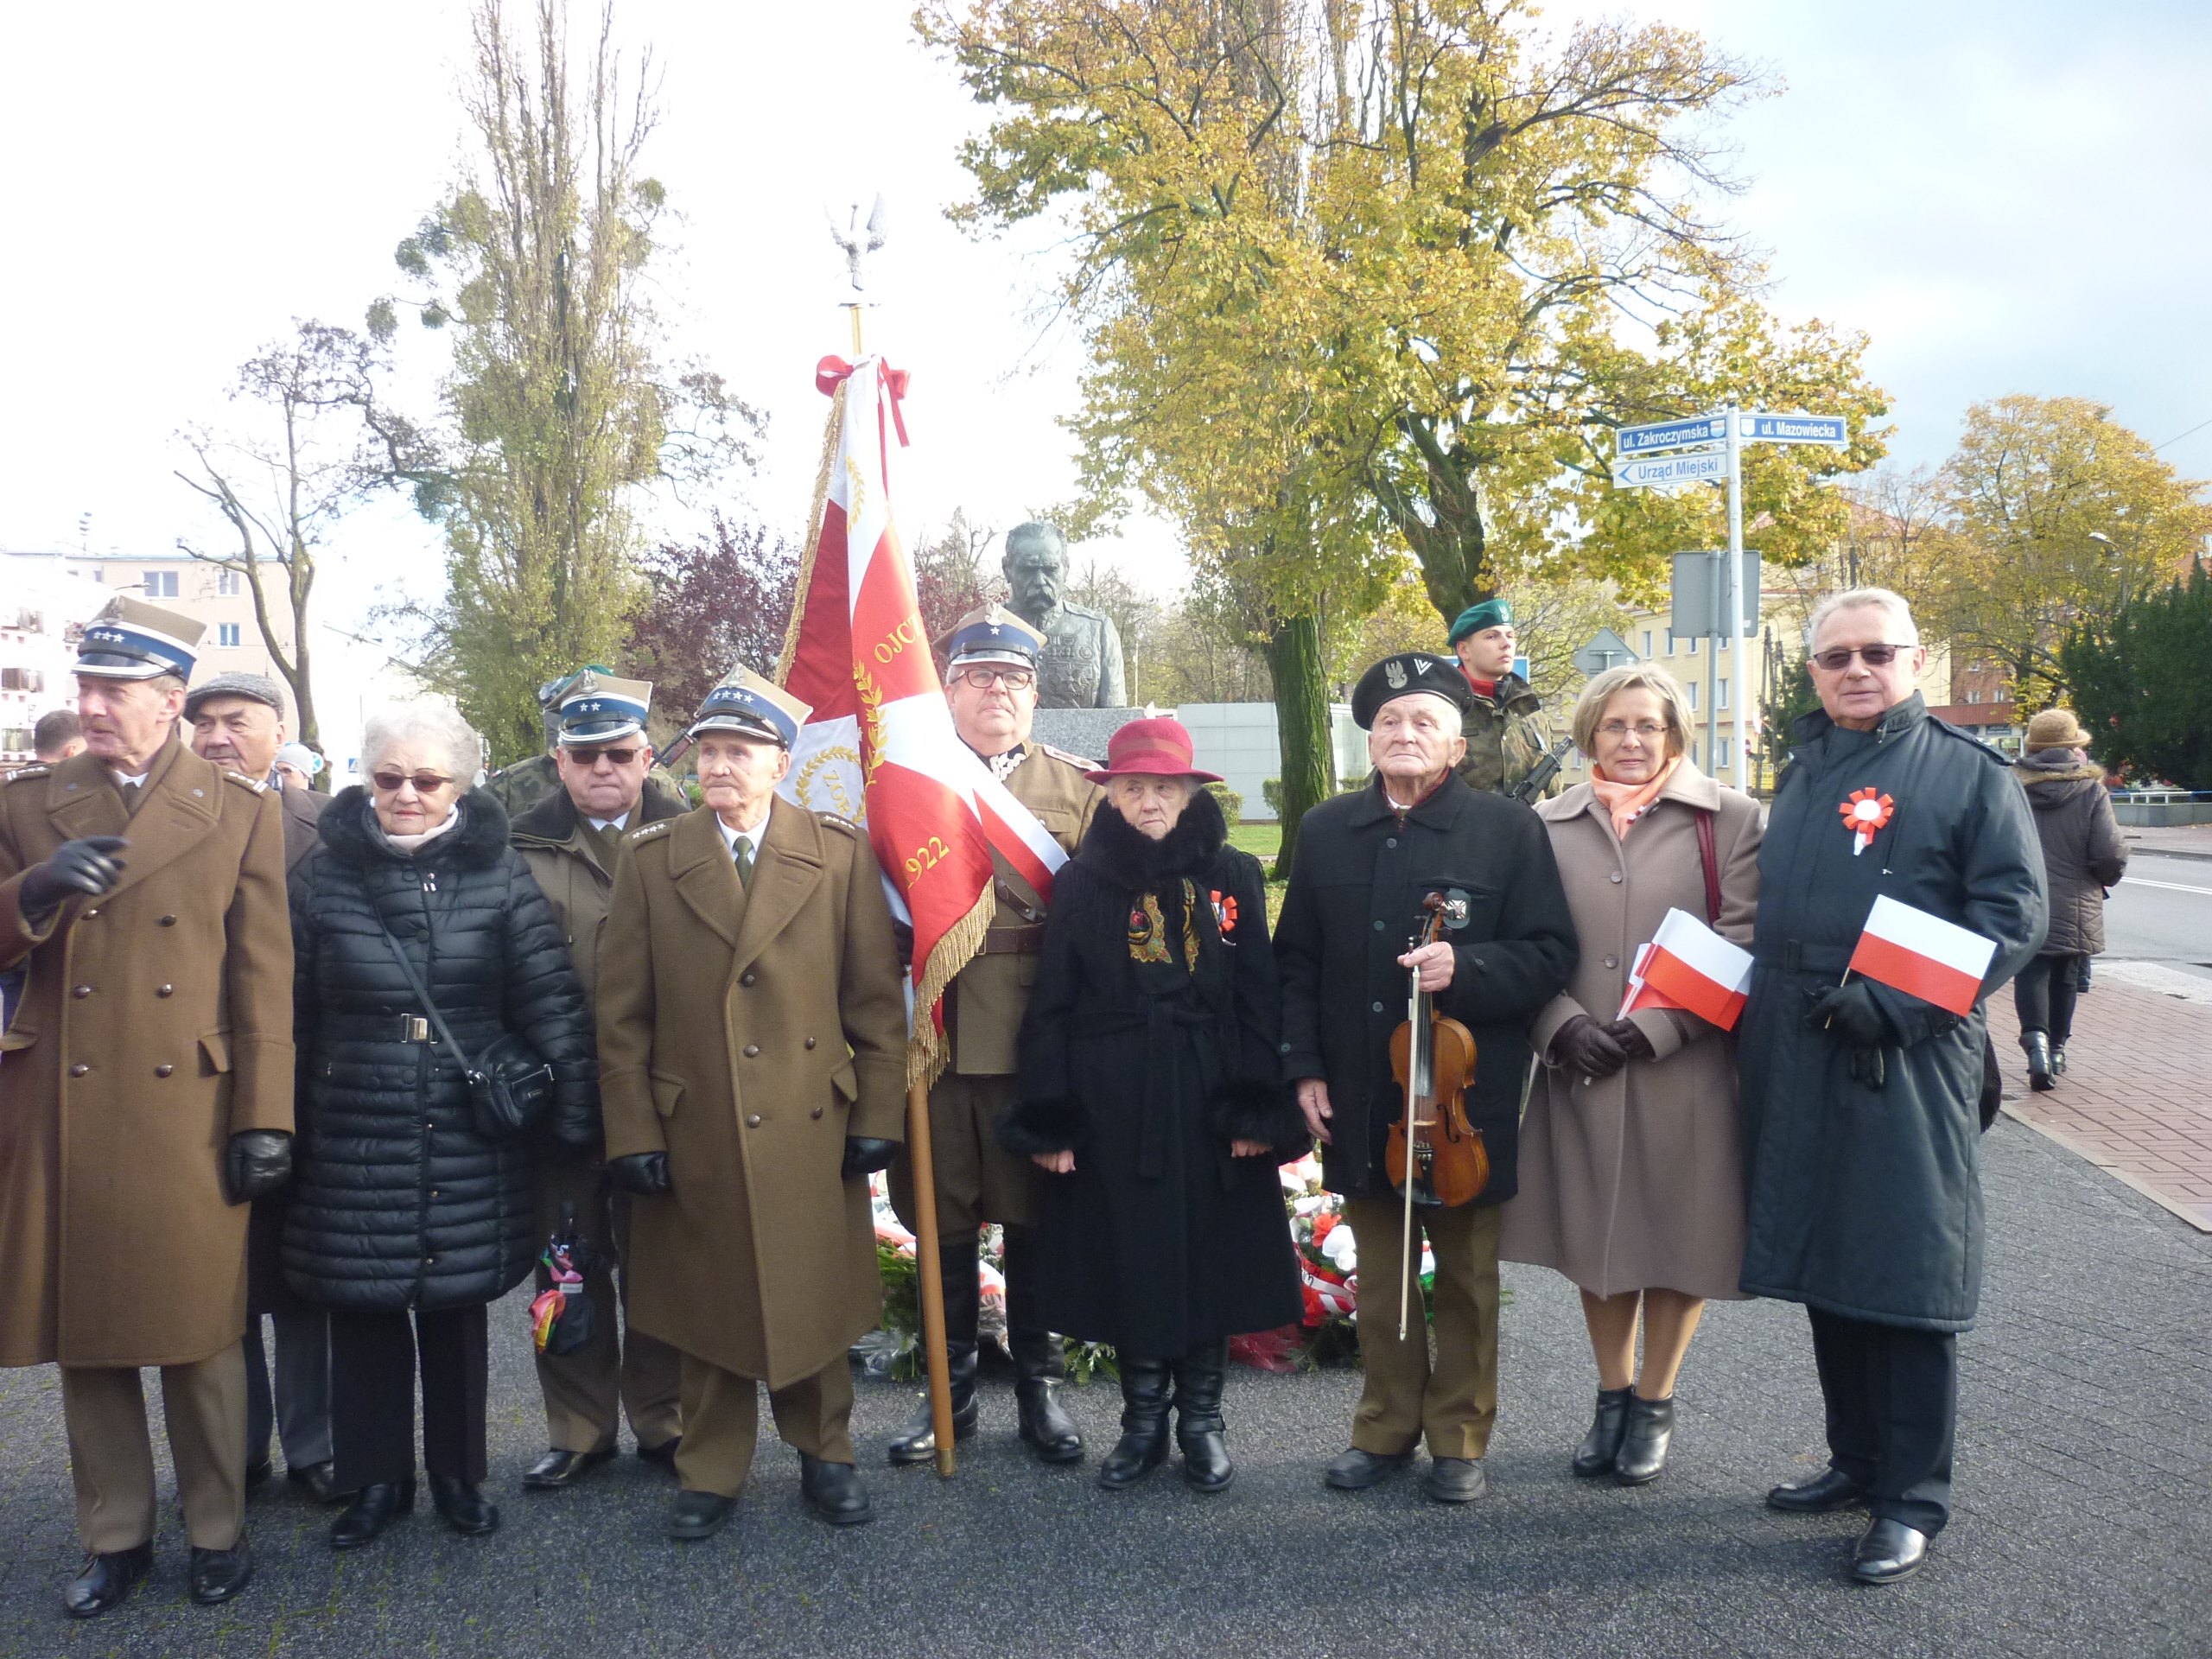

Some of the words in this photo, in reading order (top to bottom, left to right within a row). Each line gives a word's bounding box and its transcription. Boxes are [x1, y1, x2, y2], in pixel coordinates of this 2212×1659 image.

[1623, 434, 1636, 448] ul.
[1637, 424, 1709, 446] Zakroczymska
[1761, 421, 1775, 435] ul.
[1777, 421, 1836, 438] Mazowiecka
[1638, 463, 1673, 480] Urząd
[1676, 458, 1718, 478] Miejski
